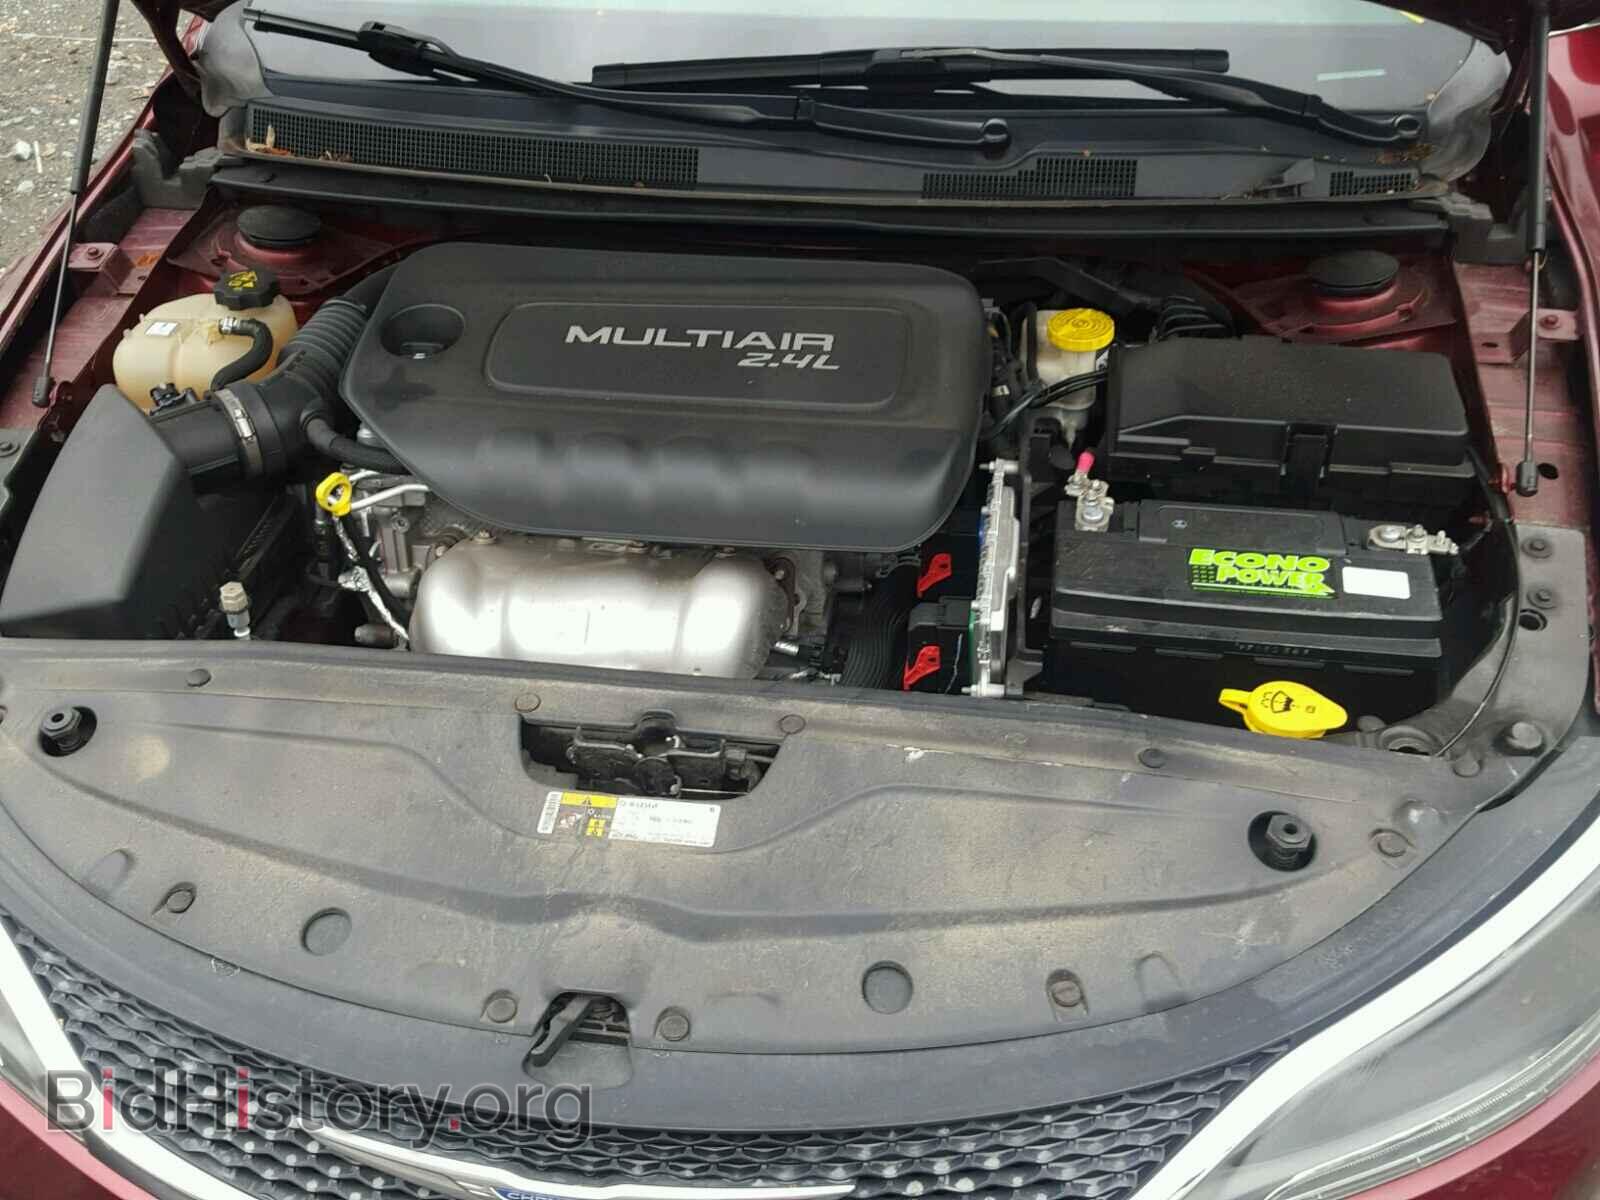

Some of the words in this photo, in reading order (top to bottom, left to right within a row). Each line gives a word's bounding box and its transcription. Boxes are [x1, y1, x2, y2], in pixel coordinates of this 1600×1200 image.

[565, 325, 835, 351] MULTIAIR
[737, 352, 840, 370] 2.4L
[1189, 548, 1331, 573] ECONO
[1216, 567, 1334, 593] POWER
